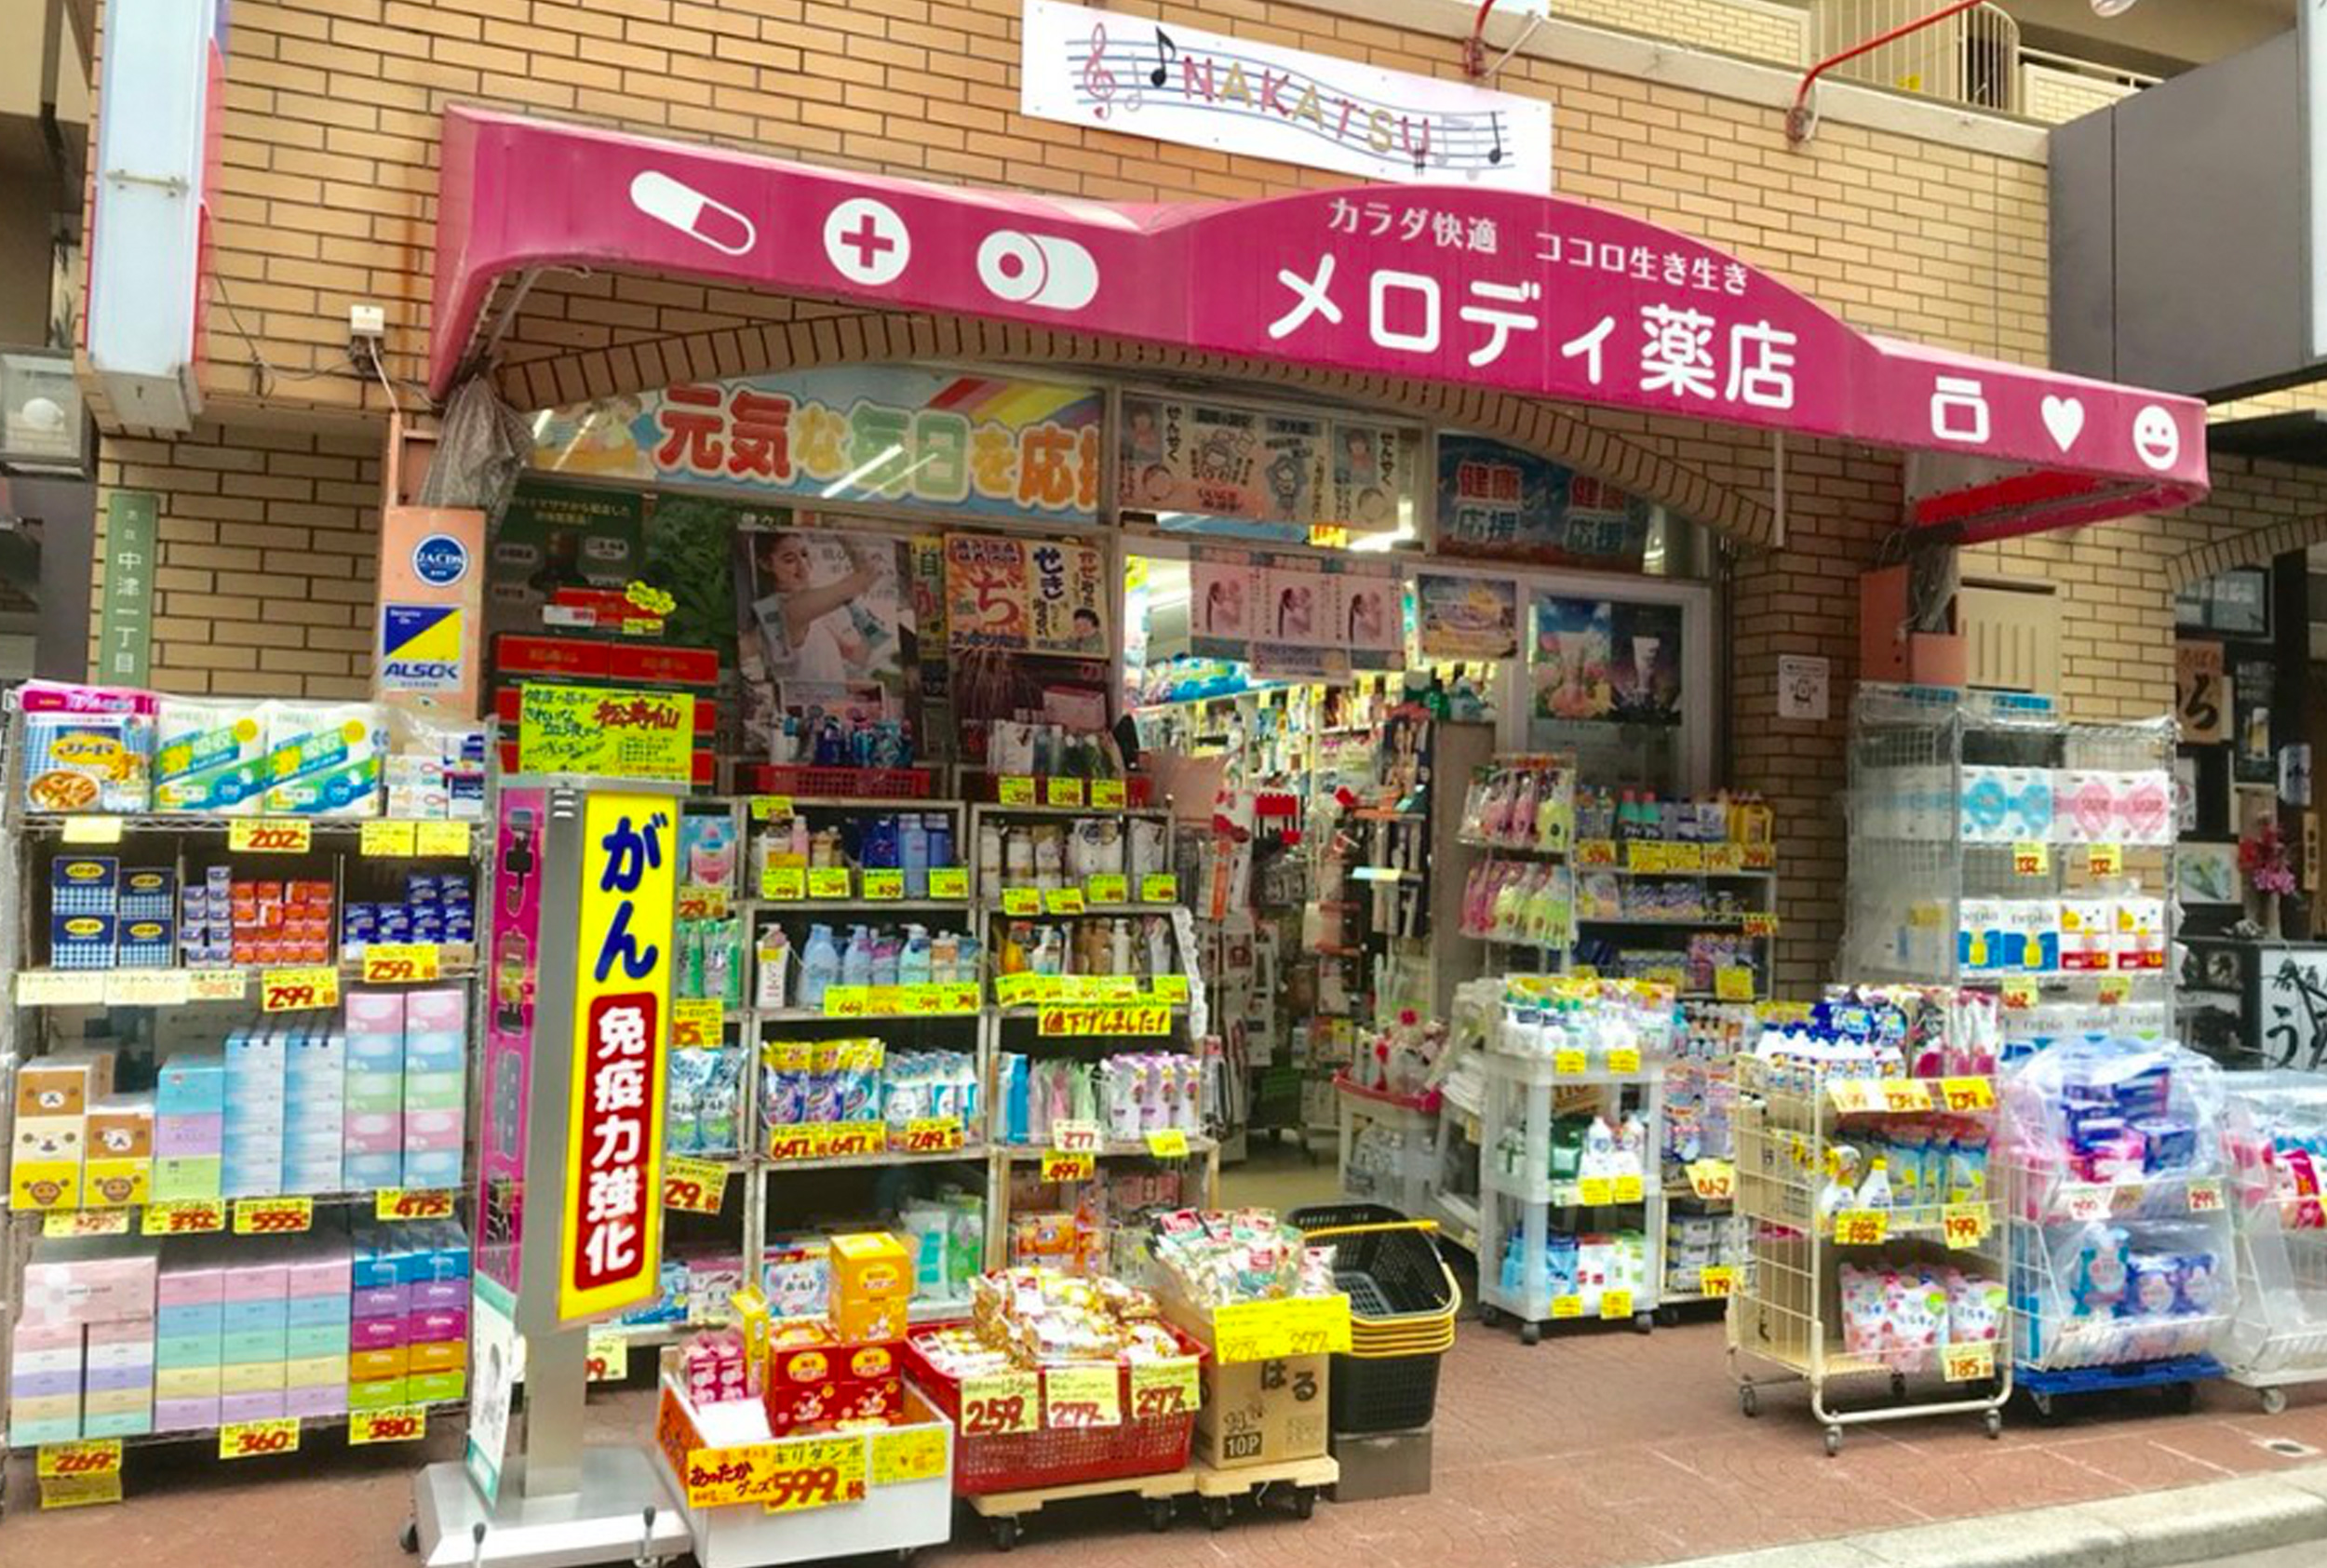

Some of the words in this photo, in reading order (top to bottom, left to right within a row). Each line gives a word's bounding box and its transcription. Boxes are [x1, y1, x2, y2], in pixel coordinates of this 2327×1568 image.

[1182, 55, 1431, 162] NAKATSU
[1327, 197, 1500, 254] カラダ快適
[1535, 232, 1749, 295] ココロ生き生き
[1268, 252, 1797, 409] メロディ薬店
[384, 663, 458, 679] ALSOK
[248, 829, 298, 849] 202
[594, 811, 668, 982] がん
[369, 960, 414, 980] 259
[267, 985, 315, 1009] 299
[585, 1006, 646, 1277] 免疫力強化
[1949, 1359, 1980, 1377] 185
[965, 1395, 1025, 1434] 259
[236, 1431, 289, 1454] 360
[1227, 1436, 1262, 1457] 10P
[768, 1465, 840, 1508] 599
